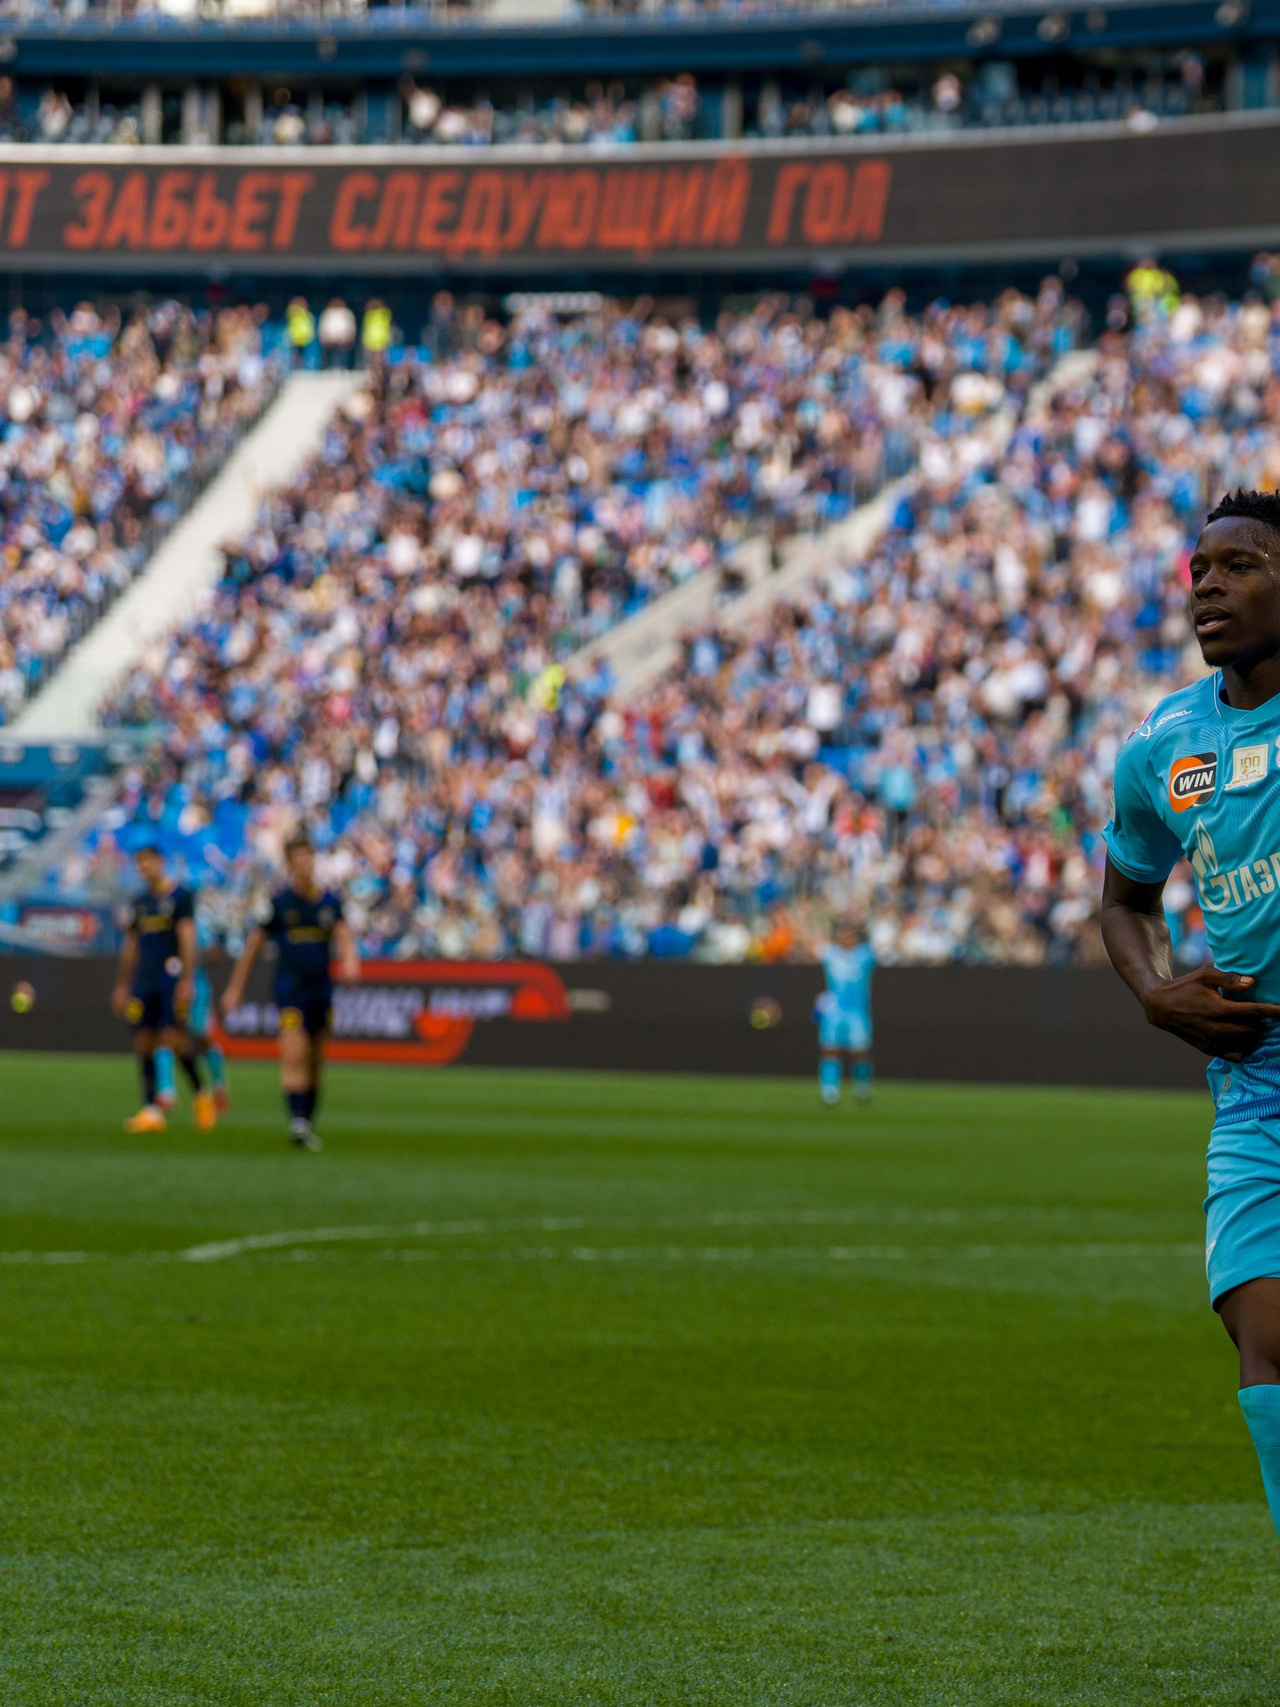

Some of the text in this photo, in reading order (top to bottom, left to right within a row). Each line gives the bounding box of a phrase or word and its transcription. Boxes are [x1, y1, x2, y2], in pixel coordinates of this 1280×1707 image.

[0, 154, 893, 263] Т ЗАБЬЕТ СЛЕДУЮЩИЙ ГОЛ
[1179, 770, 1214, 793] WIN
